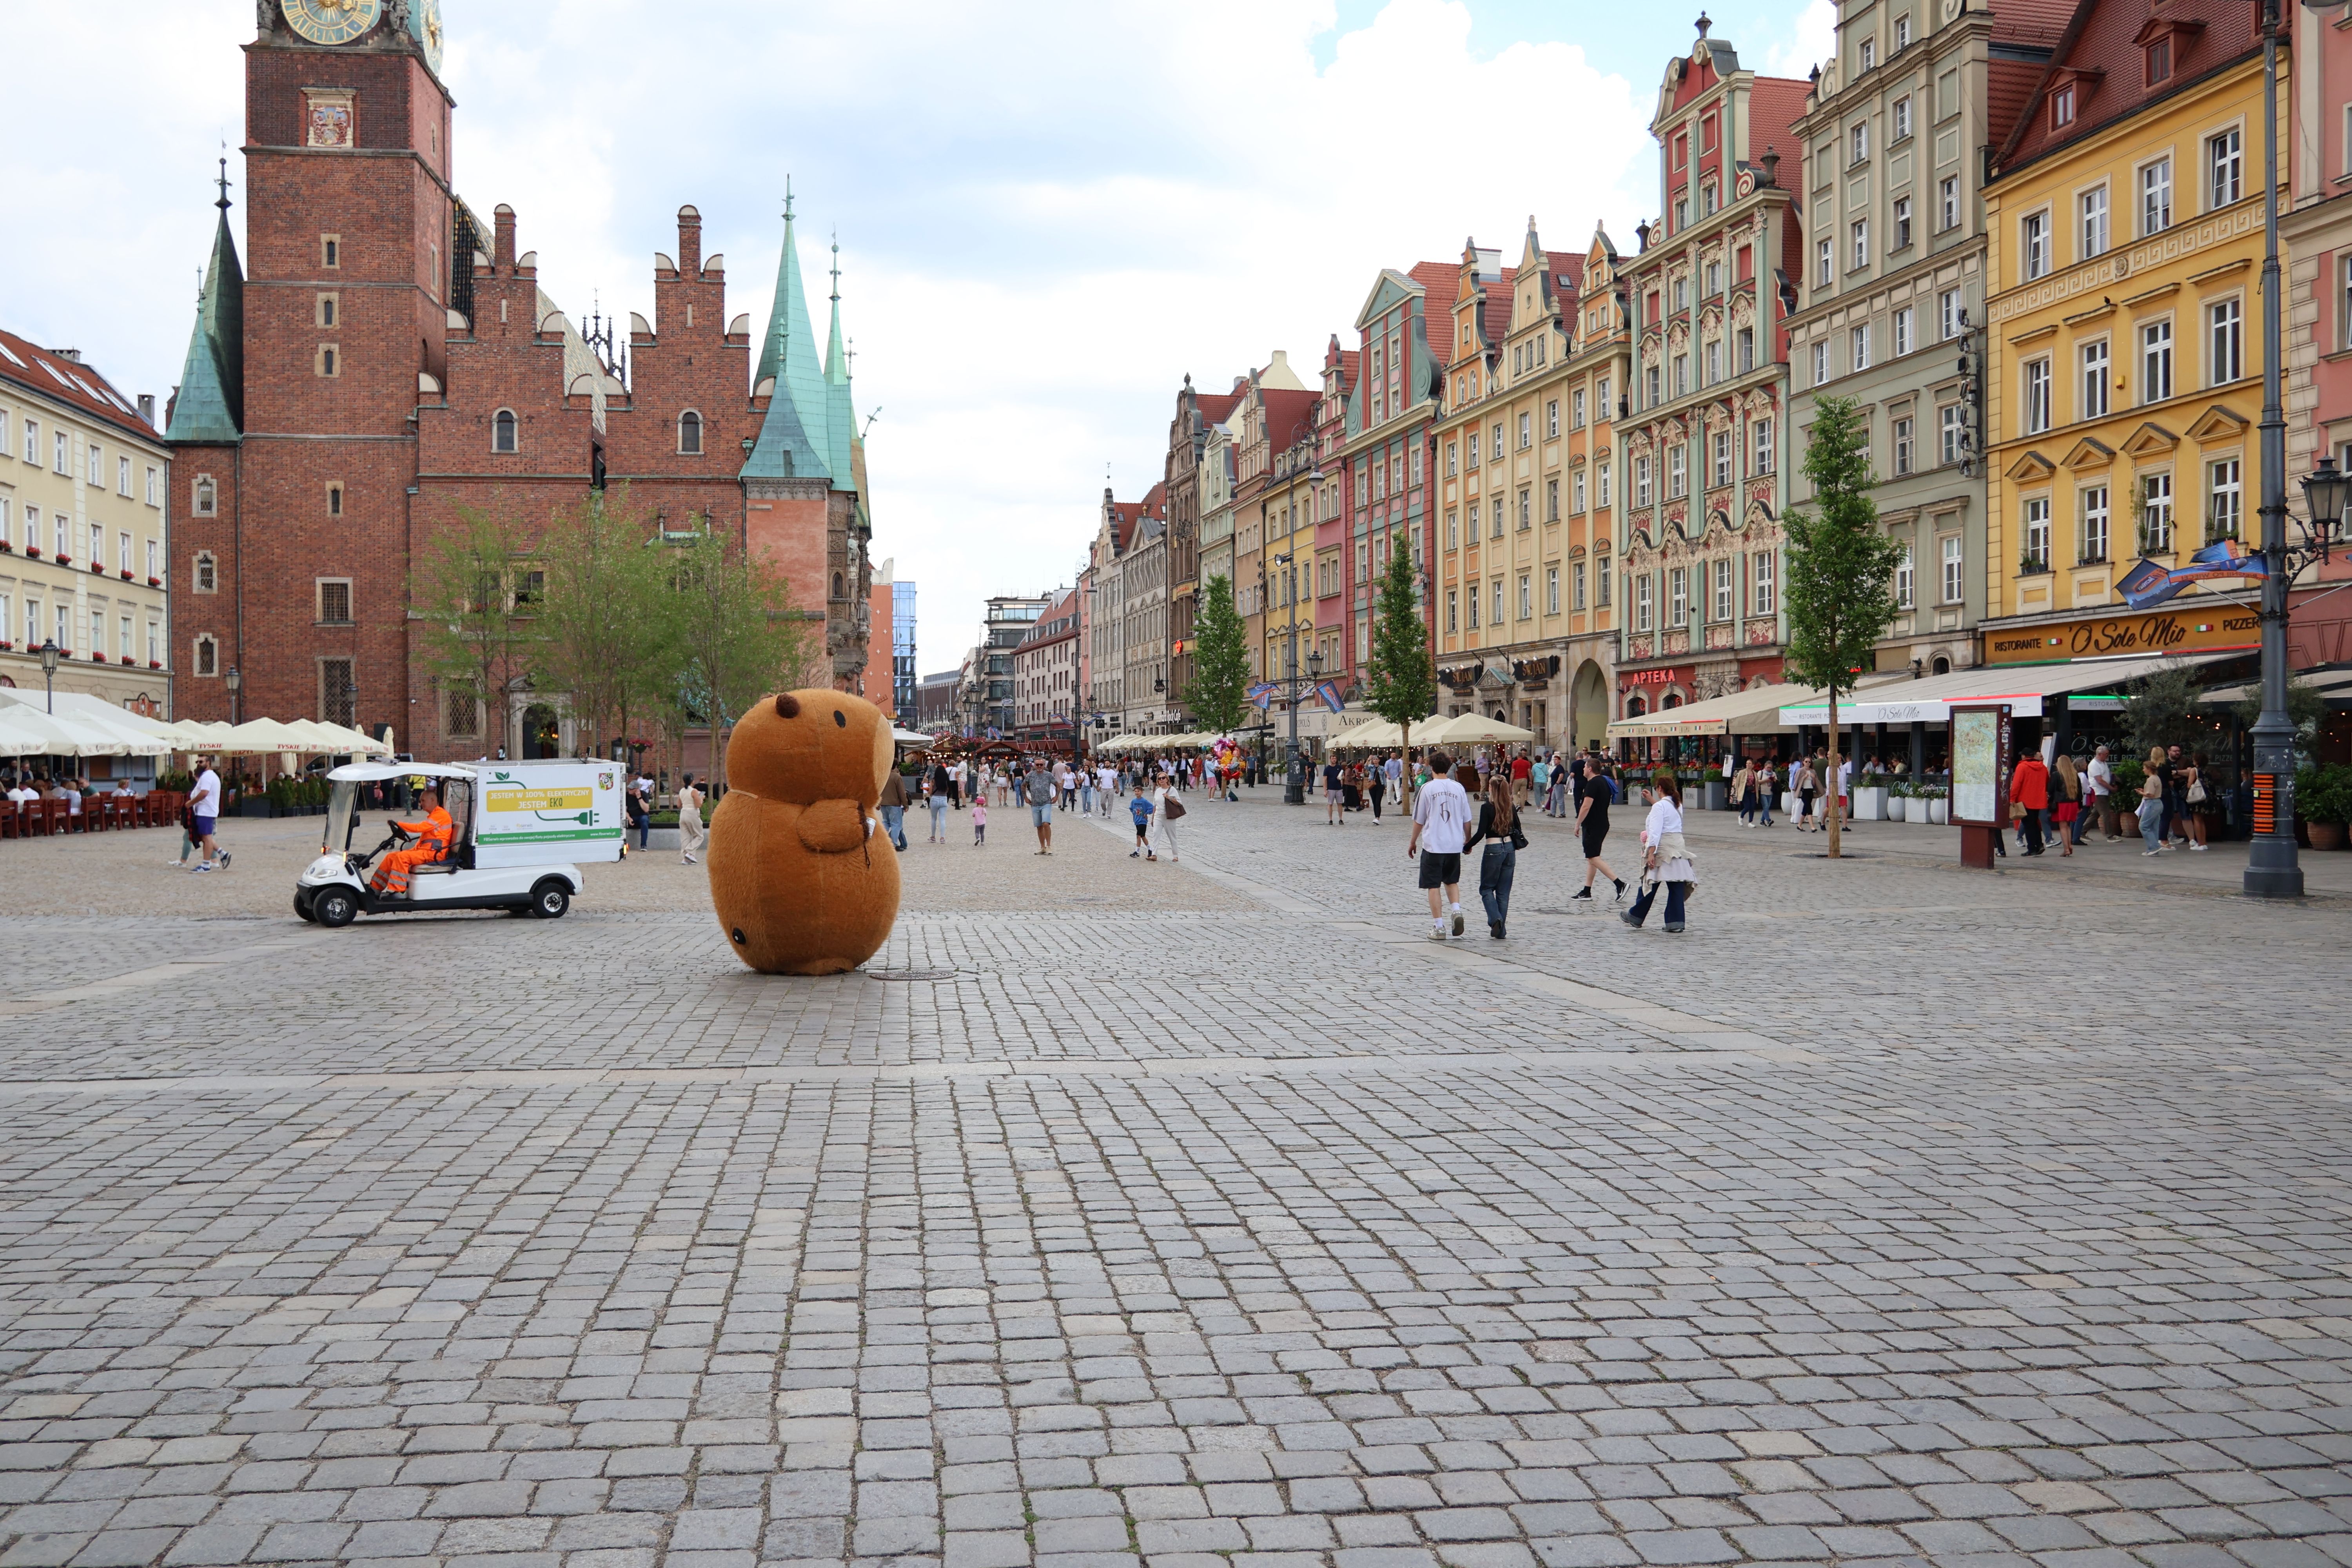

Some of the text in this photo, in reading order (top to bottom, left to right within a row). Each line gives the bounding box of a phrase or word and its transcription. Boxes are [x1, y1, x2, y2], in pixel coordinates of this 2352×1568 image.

[1994, 638, 2041, 652] RISTORANTE
[2094, 622, 2136, 652] Sole
[2139, 616, 2186, 646] Mio
[2223, 617, 2261, 631] PIZZER
[1633, 669, 1675, 684] APTEKA
[1887, 707, 1902, 719] Sole
[1903, 706, 1919, 719] Mio
[550, 798, 563, 807] EKO
